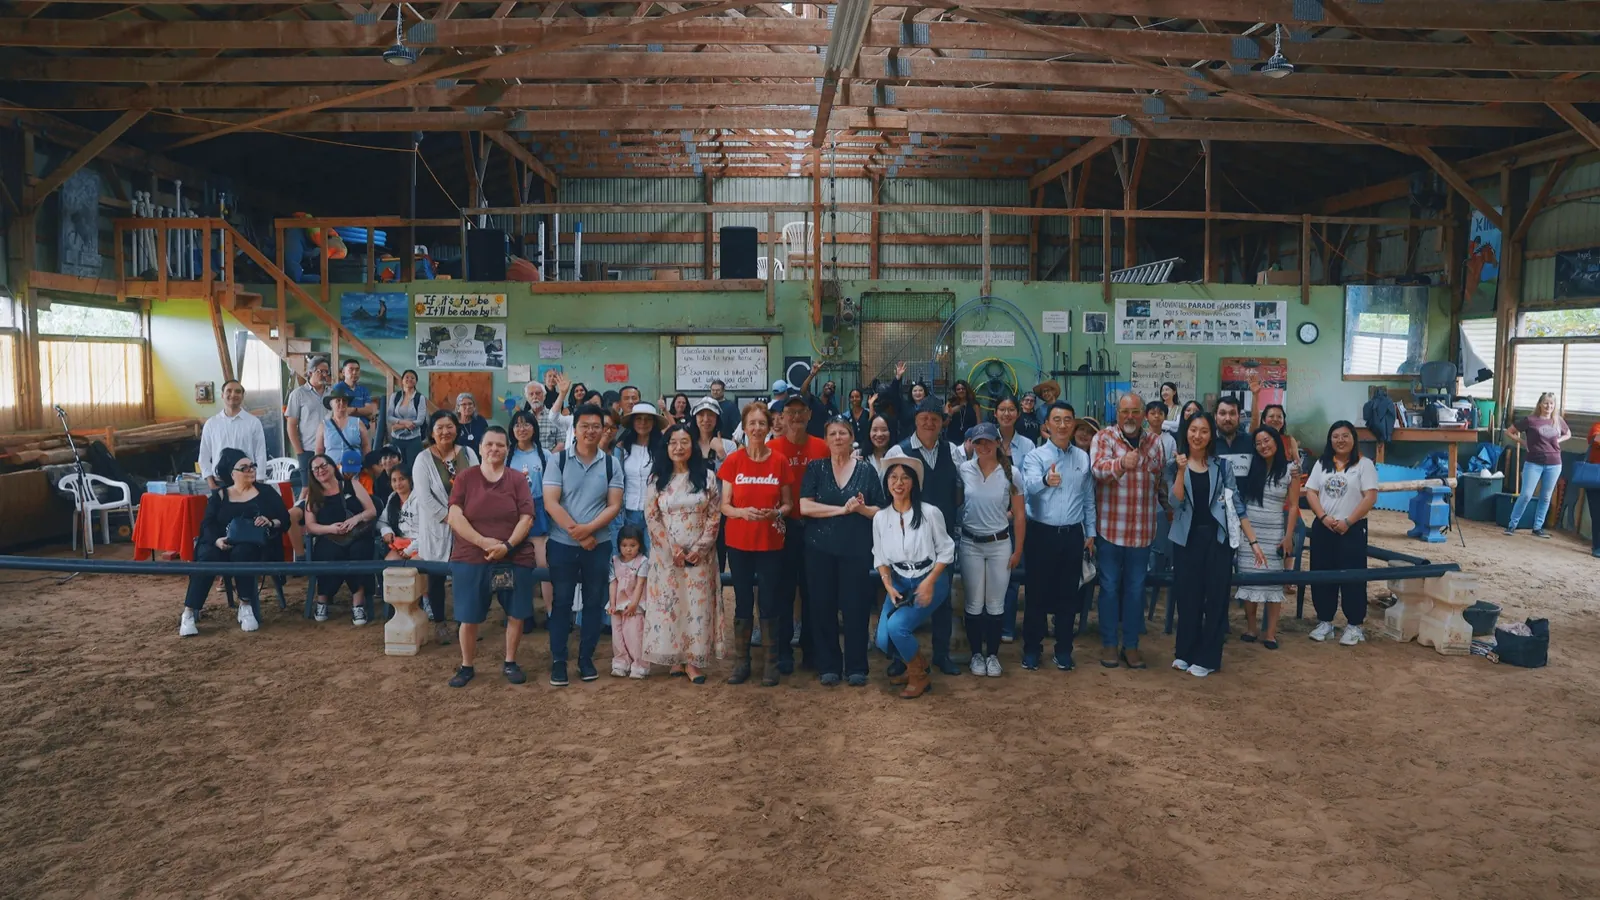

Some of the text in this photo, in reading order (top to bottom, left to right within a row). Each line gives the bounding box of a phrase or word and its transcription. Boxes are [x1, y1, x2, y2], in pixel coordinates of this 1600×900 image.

[423, 295, 489, 305] If it's to be
[425, 306, 445, 316] It'll
[447, 307, 458, 316] be
[460, 307, 479, 316] done
[480, 306, 490, 317] by
[728, 348, 737, 356] you
[740, 347, 749, 355] get
[437, 359, 467, 367] Canadian
[689, 368, 720, 376] Experience
[731, 368, 745, 376] what
[735, 473, 779, 485] Canada
